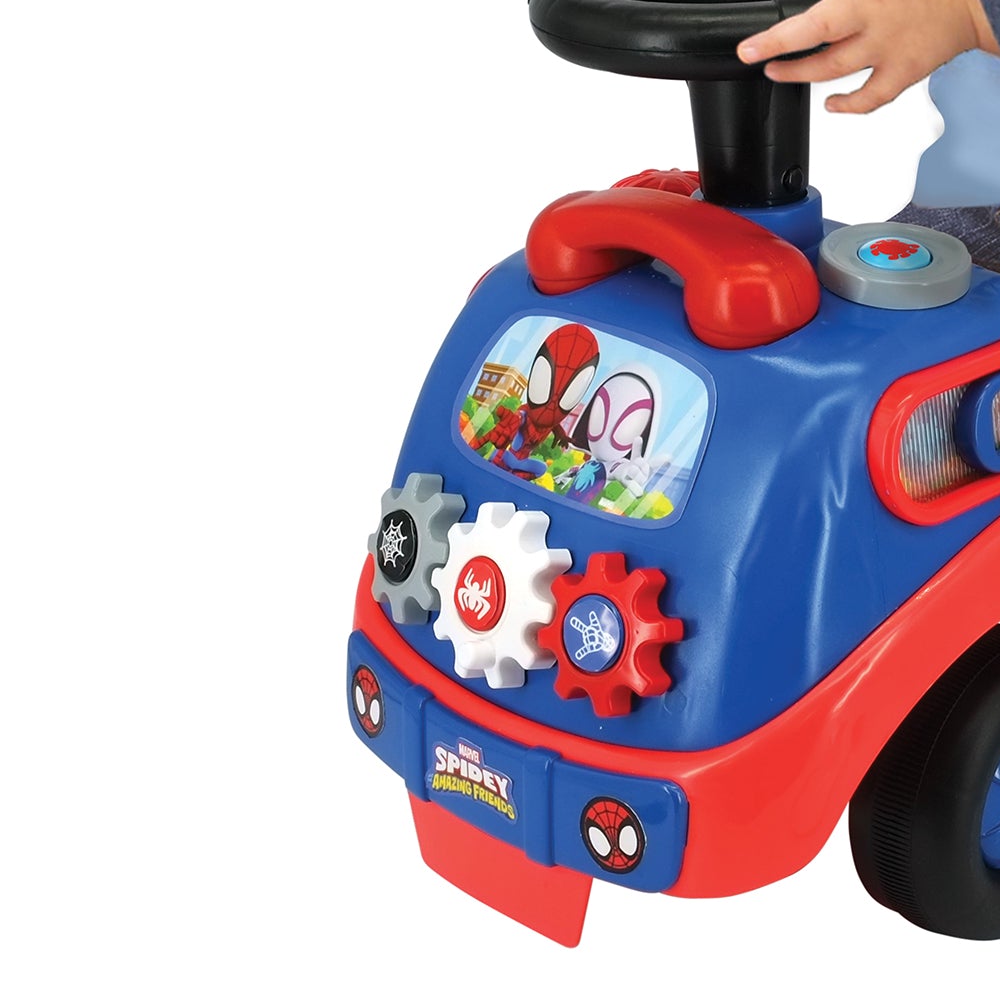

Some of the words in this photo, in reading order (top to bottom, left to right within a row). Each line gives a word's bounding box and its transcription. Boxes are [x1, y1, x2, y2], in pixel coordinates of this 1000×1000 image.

[435, 746, 508, 800] SPIDEY
[458, 743, 480, 764] MARVEL
[432, 774, 472, 795] AMAZING
[473, 784, 515, 820] FRIENDS
